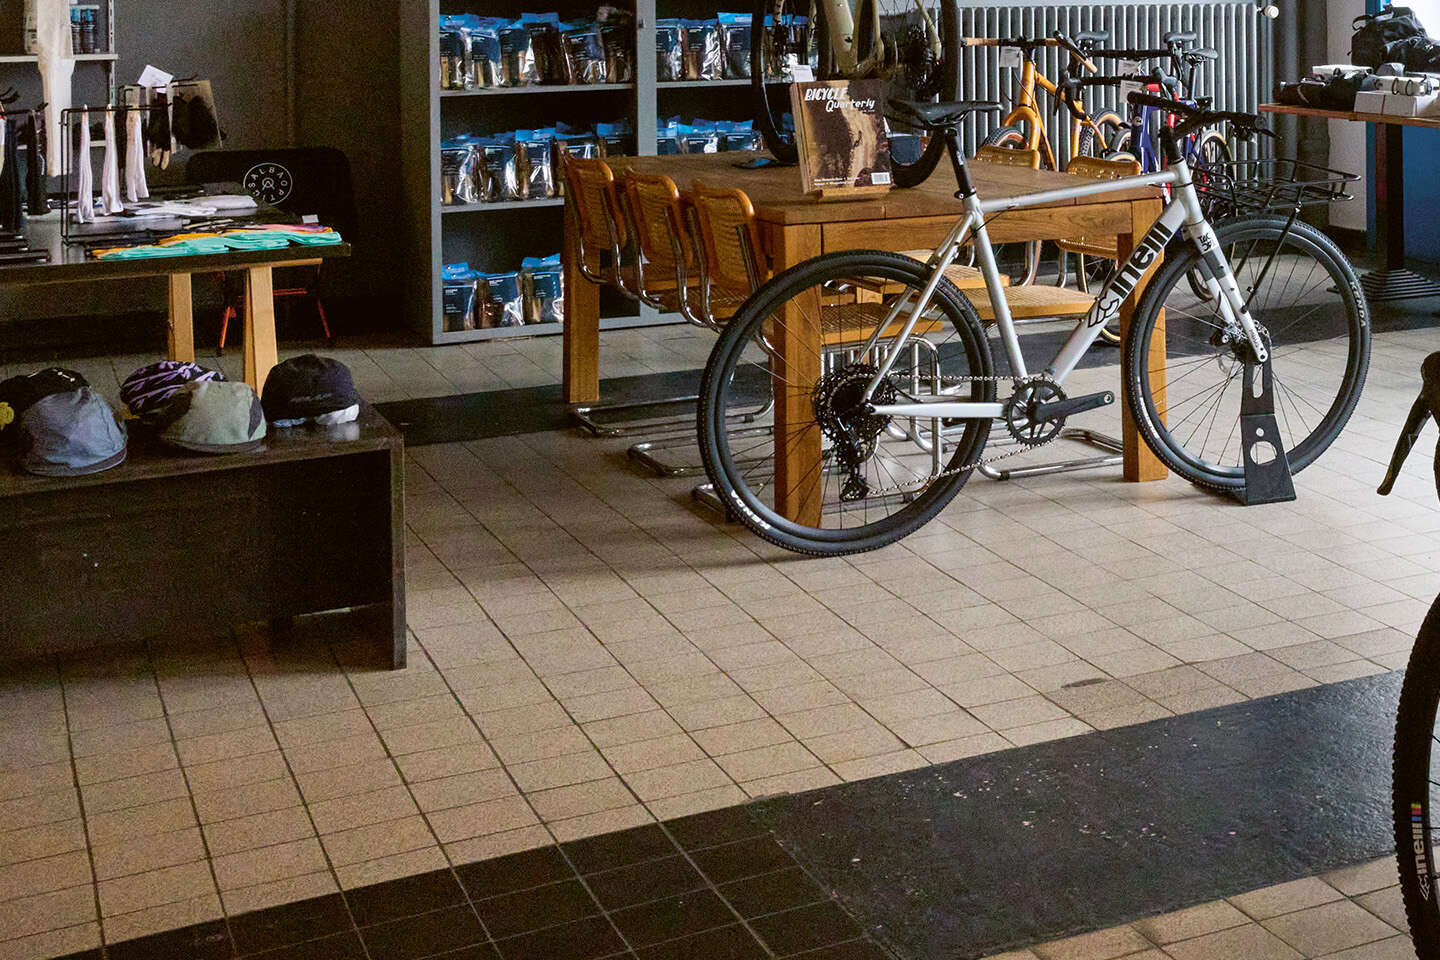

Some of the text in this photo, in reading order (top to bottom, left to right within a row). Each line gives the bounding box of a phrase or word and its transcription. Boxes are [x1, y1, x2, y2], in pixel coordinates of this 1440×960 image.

[804, 87, 849, 101] BICYCLE
[825, 98, 875, 112] Quarterly
[1350, 280, 1367, 327] KENDA
